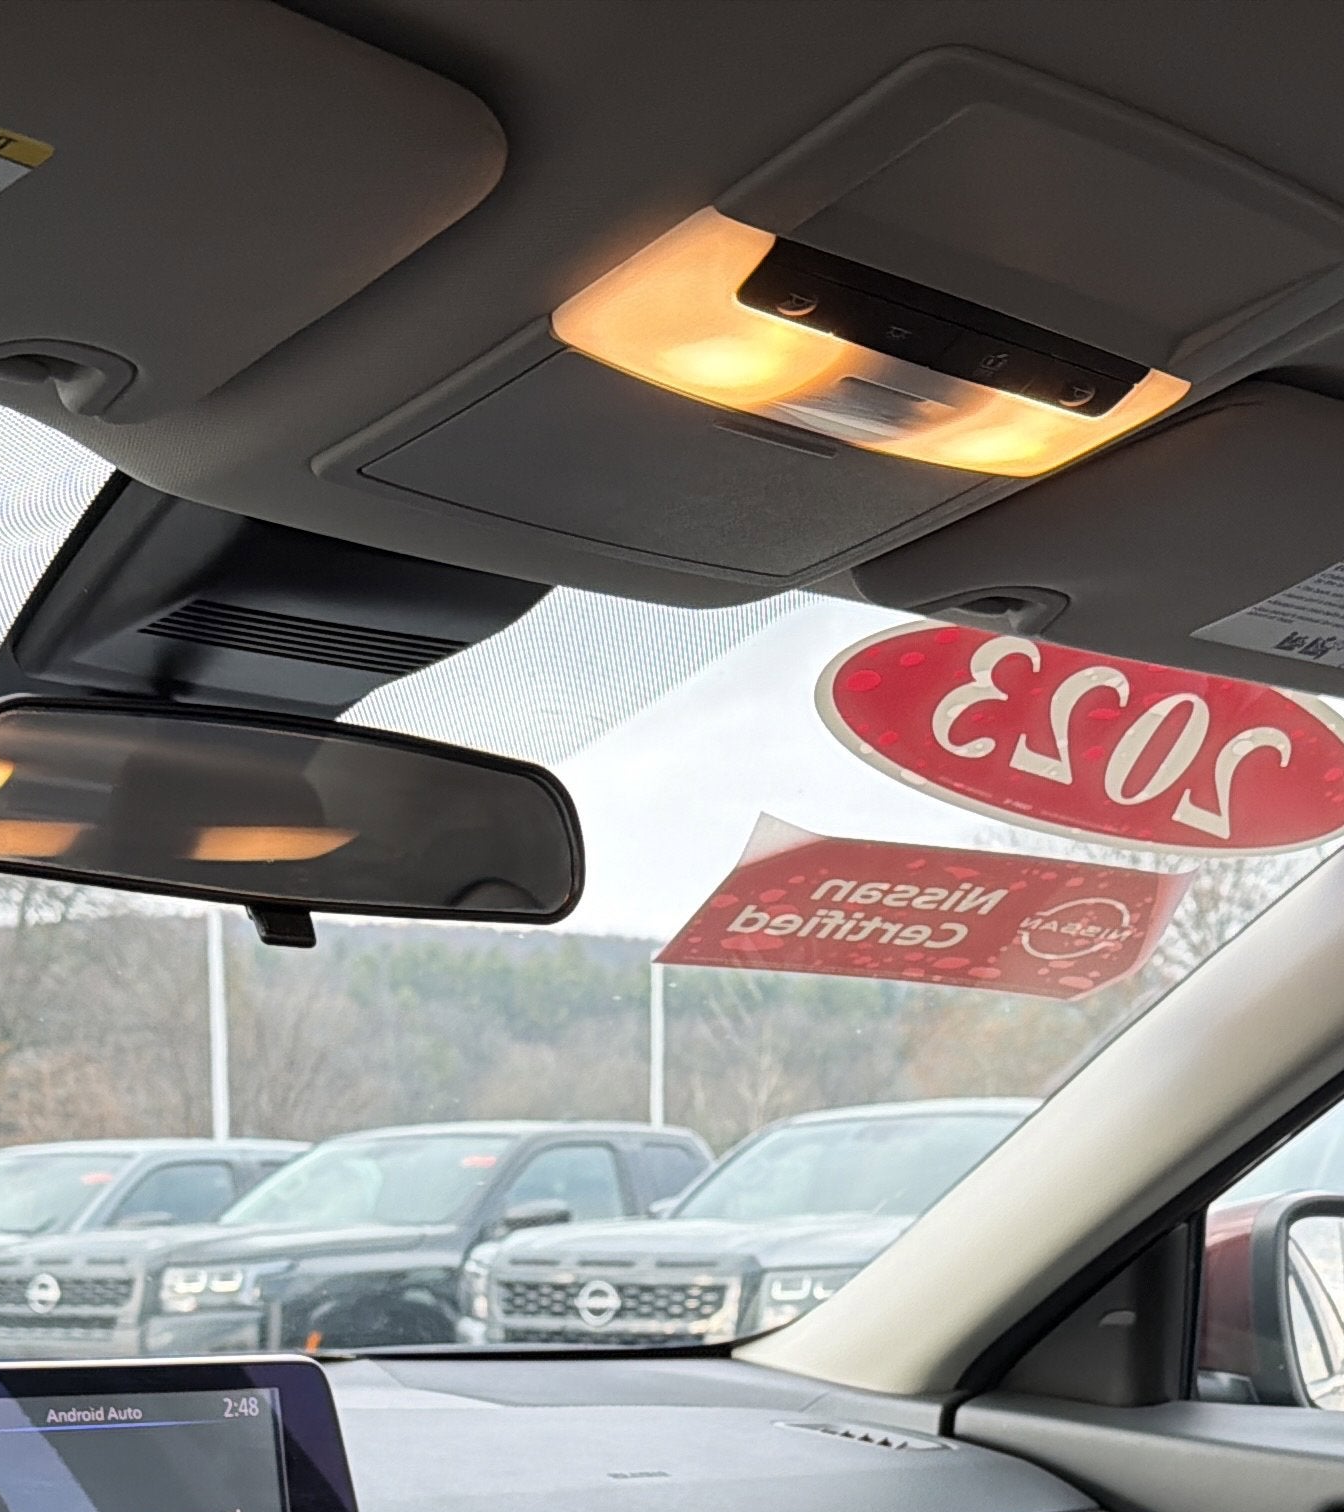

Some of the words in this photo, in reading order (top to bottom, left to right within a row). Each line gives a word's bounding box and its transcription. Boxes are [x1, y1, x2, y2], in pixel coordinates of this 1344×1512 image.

[47, 1405, 103, 1422] Android
[107, 1405, 143, 1421] Auto
[222, 1396, 260, 1419] 2:48
